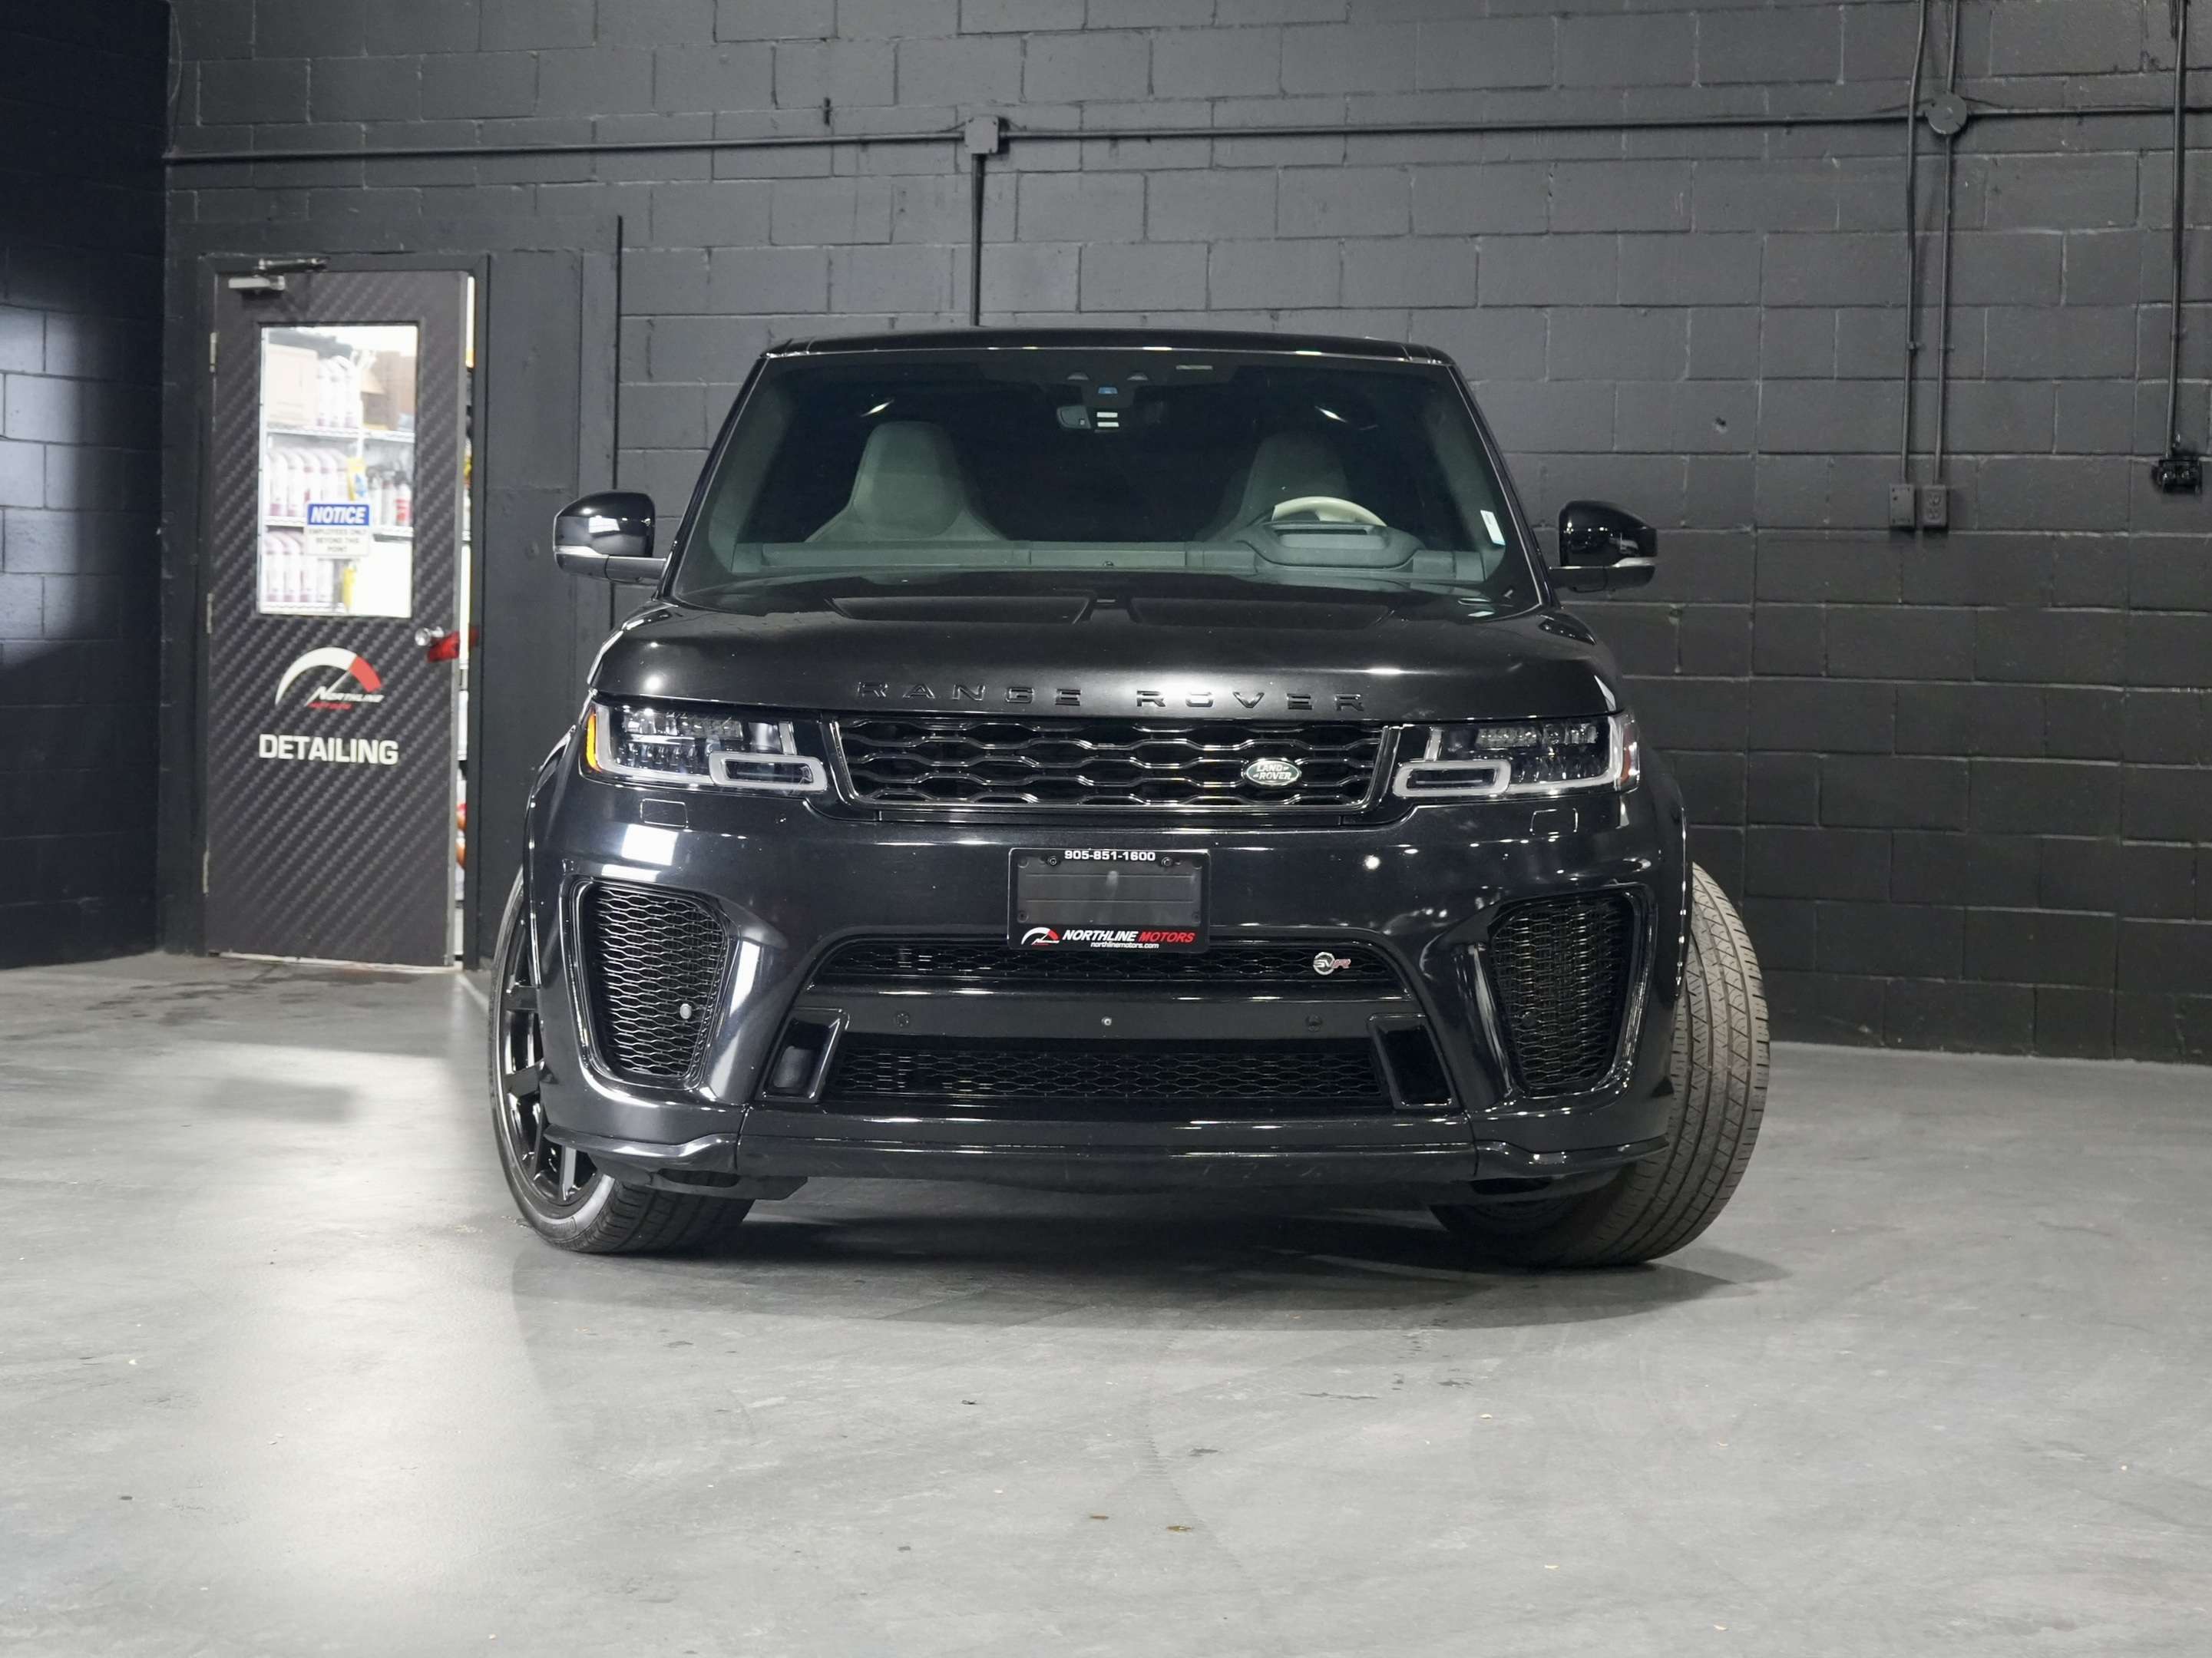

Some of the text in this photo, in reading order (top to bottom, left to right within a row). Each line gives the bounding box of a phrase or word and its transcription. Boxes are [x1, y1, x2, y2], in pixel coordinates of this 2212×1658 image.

[310, 506, 367, 524] NOTICE
[857, 682, 1364, 711] RANGE ROVER
[259, 733, 399, 765] DETAILING
[1257, 764, 1283, 772] LAND
[1259, 771, 1291, 780] ROVER
[1064, 850, 1156, 861] 905-851-1600
[1062, 930, 1195, 943] NORTHLINE MOTORS
